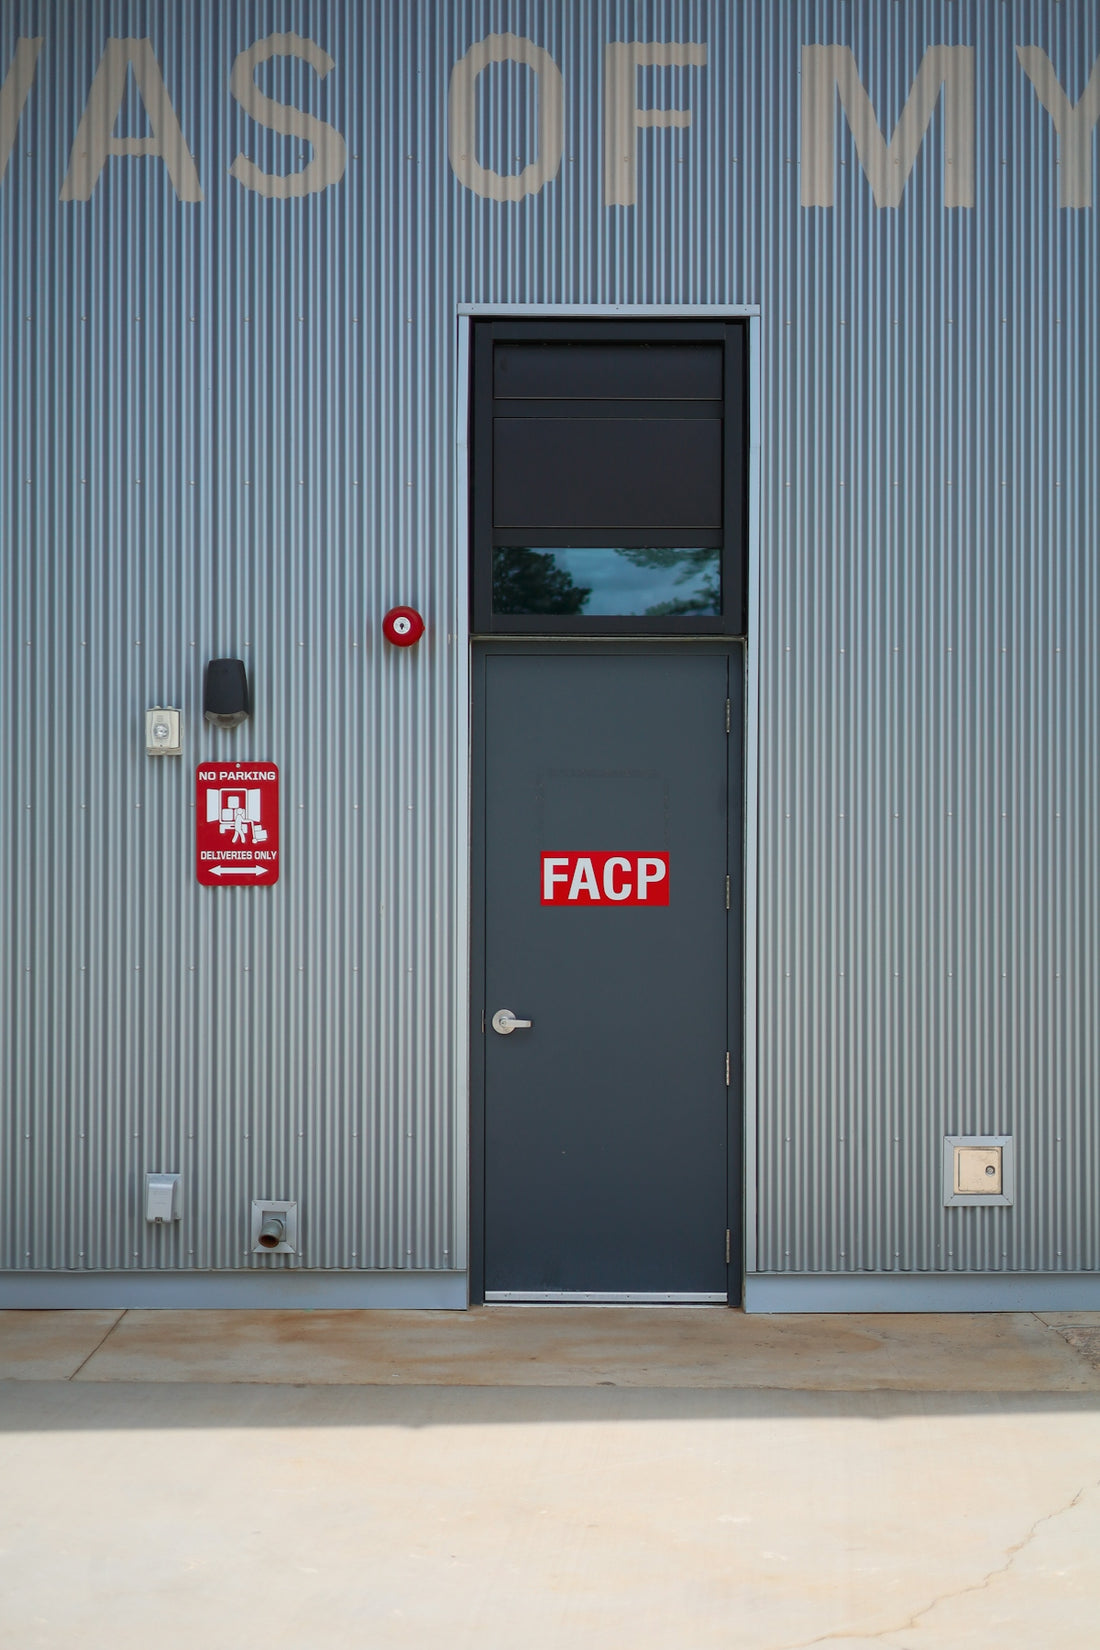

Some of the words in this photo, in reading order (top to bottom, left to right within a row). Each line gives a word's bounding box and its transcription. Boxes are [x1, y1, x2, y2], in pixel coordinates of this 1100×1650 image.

[449, 32, 707, 206] OF
[800, 43, 1100, 208] MY
[199, 771, 216, 780] NO
[220, 771, 276, 780] PARKING
[200, 850, 253, 860] DELIVERIES
[254, 850, 277, 860] ONLY
[543, 856, 666, 900] FACP
